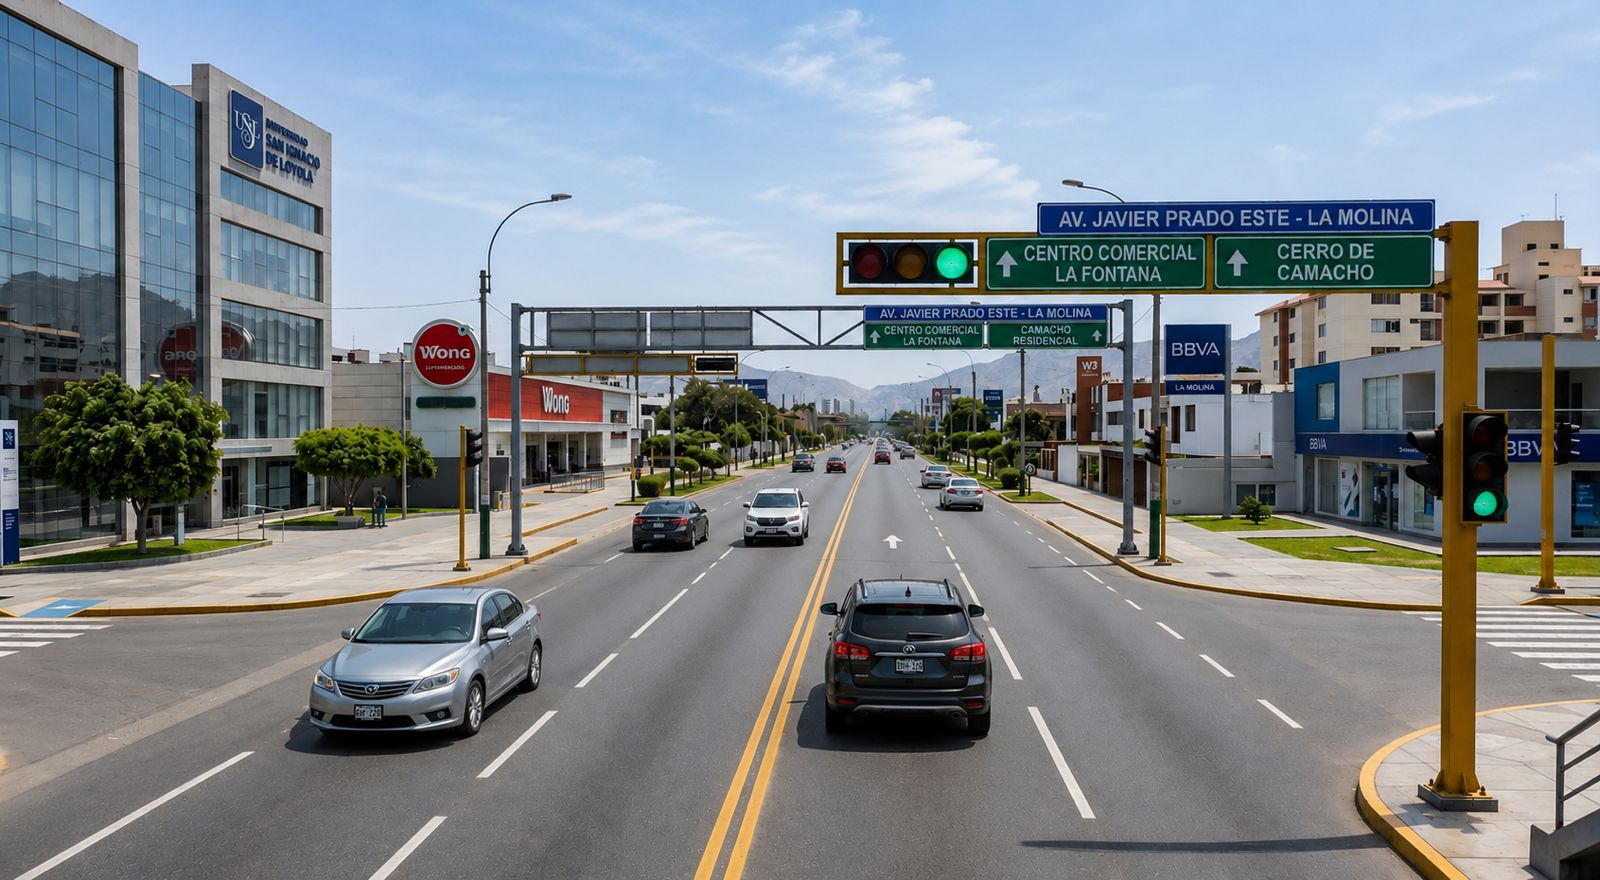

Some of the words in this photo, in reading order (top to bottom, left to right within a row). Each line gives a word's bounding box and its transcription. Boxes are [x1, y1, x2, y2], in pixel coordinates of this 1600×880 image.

[265, 133, 285, 155] SAN
[285, 143, 321, 170] IGNACIO
[265, 151, 279, 169] DE
[279, 157, 314, 184] LOYOLA
[1059, 210, 1087, 228] AV.
[1092, 210, 1160, 228] JAVIER
[1165, 209, 1235, 227] PRADO
[1240, 209, 1290, 226] ESTE
[1308, 208, 1333, 226] LA
[1338, 208, 1414, 225] MOLINA
[1024, 244, 1094, 261] CENTRO
[1098, 244, 1197, 261] COMERCIAL
[1277, 243, 1344, 260] CERRO
[1349, 243, 1375, 259] DE
[1055, 266, 1078, 282] LA
[1082, 265, 1162, 282] FONTANA
[1277, 264, 1374, 281] CAMACHO
[880, 308, 897, 319] AV.
[900, 308, 940, 319] JAVIER
[943, 308, 985, 319] PRADO
[988, 307, 1018, 318] ESTE
[1028, 307, 1044, 318] LA
[1046, 307, 1093, 318] MOLINA
[884, 325, 923, 335] CENTRO
[924, 325, 980, 335] COMERCIAL
[1020, 325, 1072, 334] CAMACHO
[903, 337, 916, 346] LA
[917, 337, 962, 346] FONTANA
[1013, 336, 1079, 345] RESIDENCIAL
[1171, 342, 1221, 357] BBVA
[1081, 360, 1098, 370] W3
[1309, 438, 1327, 450] BBVA
[1507, 440, 1558, 457] BBV
